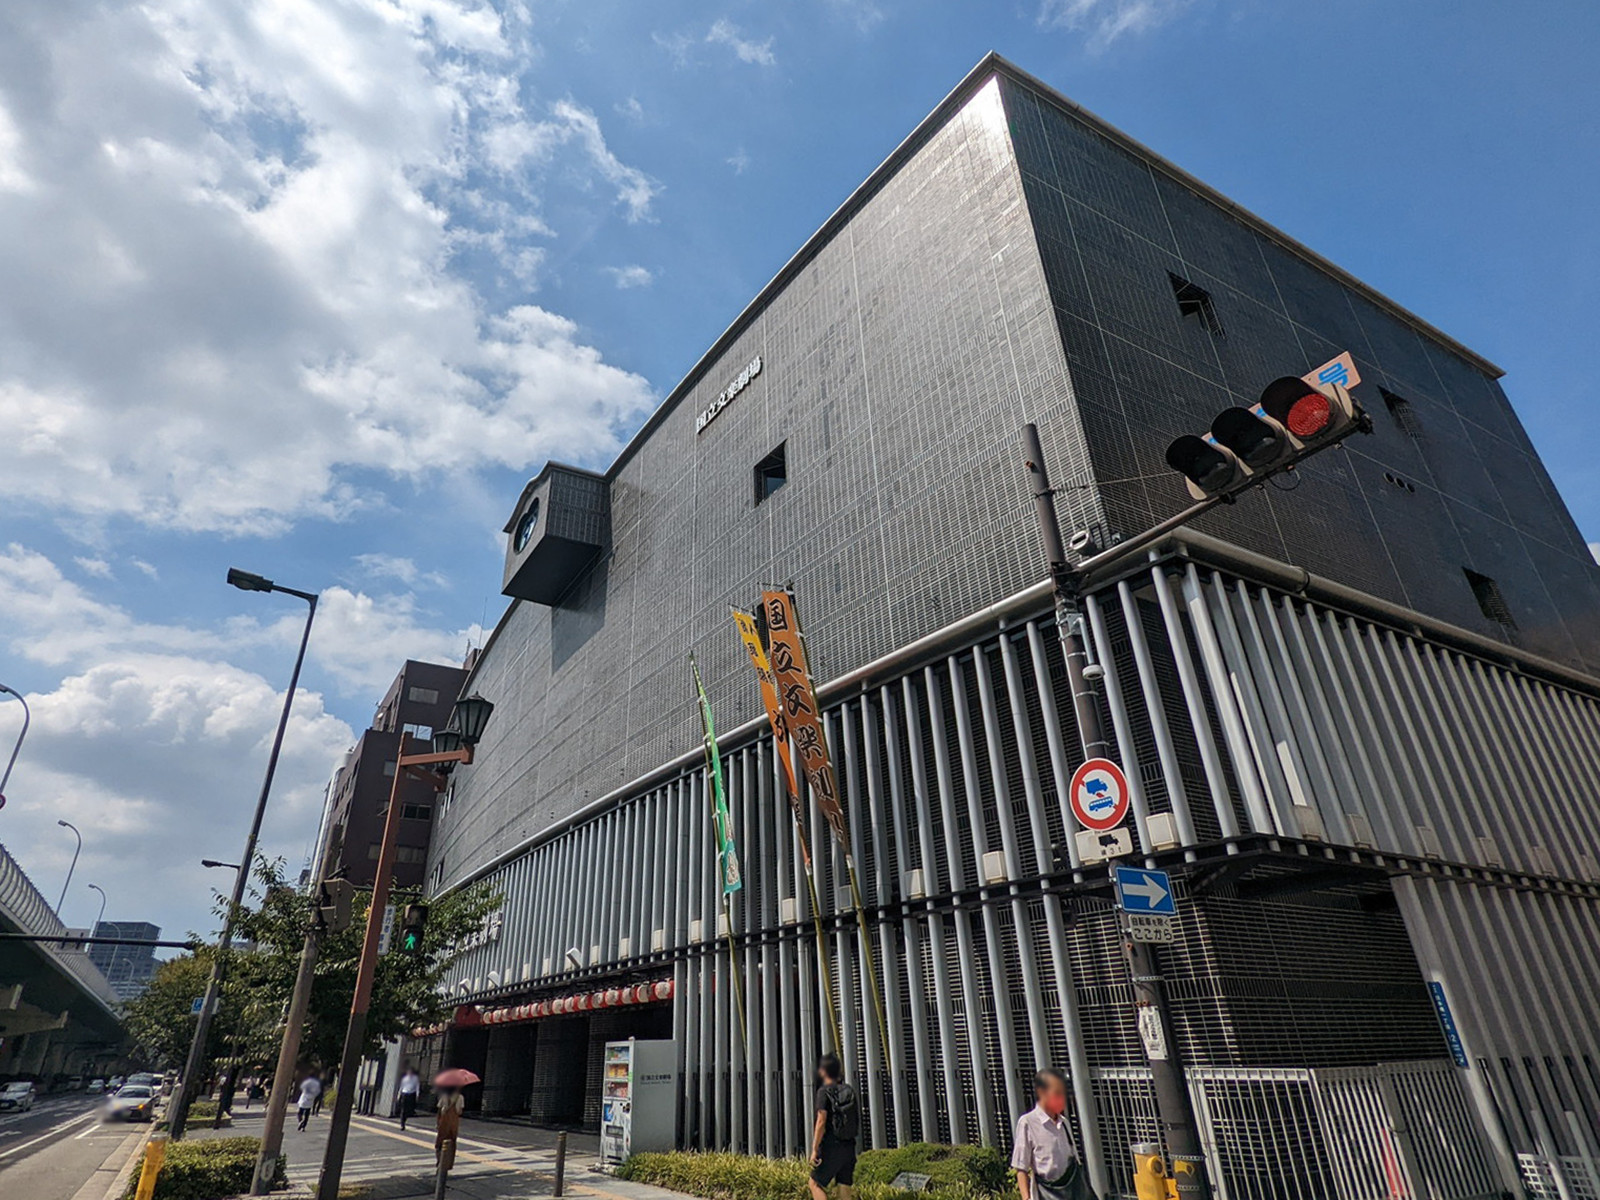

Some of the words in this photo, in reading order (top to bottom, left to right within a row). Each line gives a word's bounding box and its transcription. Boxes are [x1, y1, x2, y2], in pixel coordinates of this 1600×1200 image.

[696, 355, 762, 434] 国立文楽劇場
[1134, 928, 1172, 941] ここから
